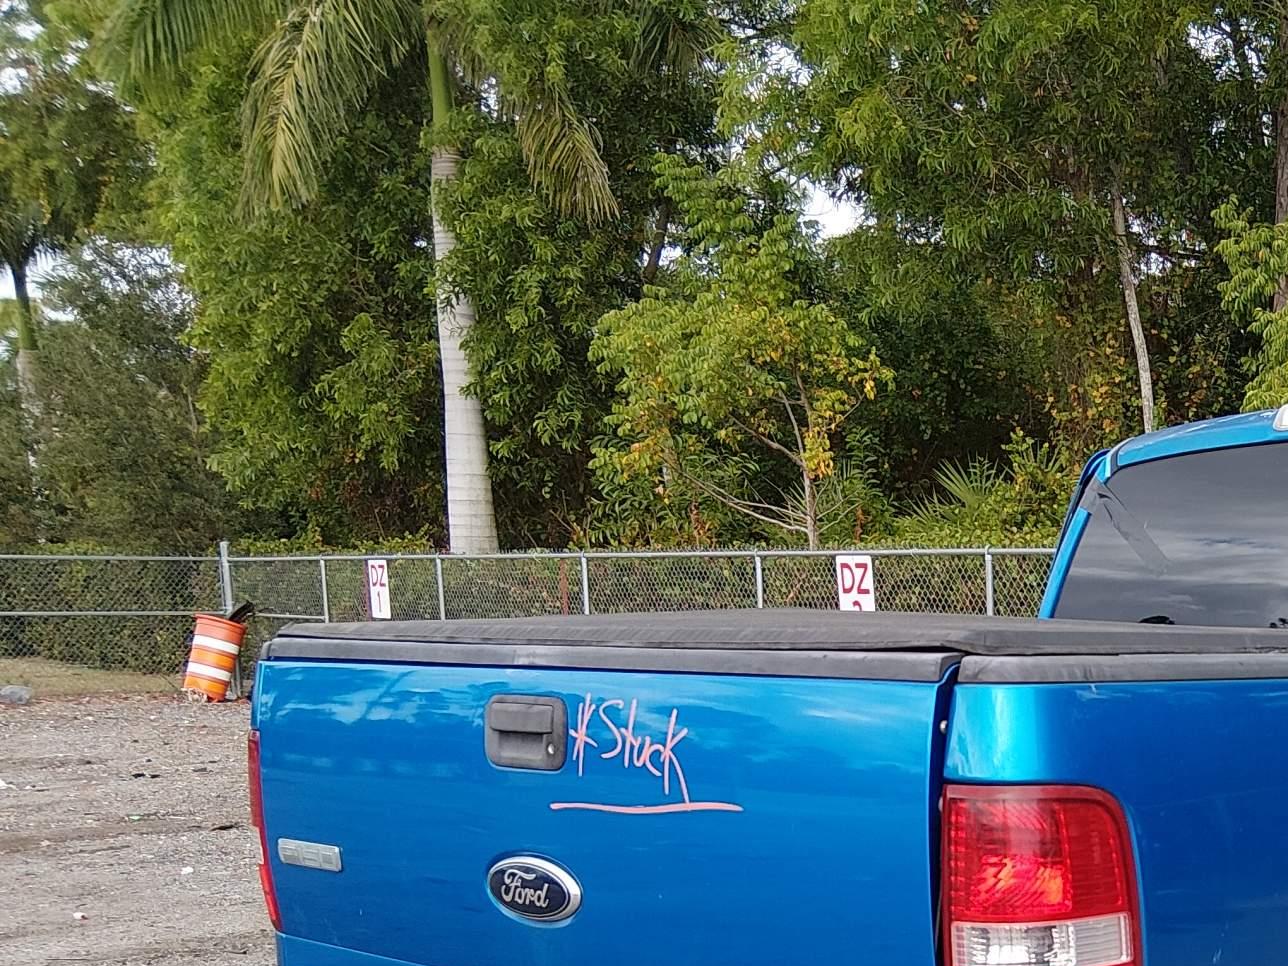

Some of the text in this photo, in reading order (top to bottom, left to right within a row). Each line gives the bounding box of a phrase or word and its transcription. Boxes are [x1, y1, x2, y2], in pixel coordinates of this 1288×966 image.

[370, 564, 386, 587] DZ
[840, 562, 870, 594] DZ
[377, 590, 382, 613] 1
[501, 869, 549, 908] Ford
